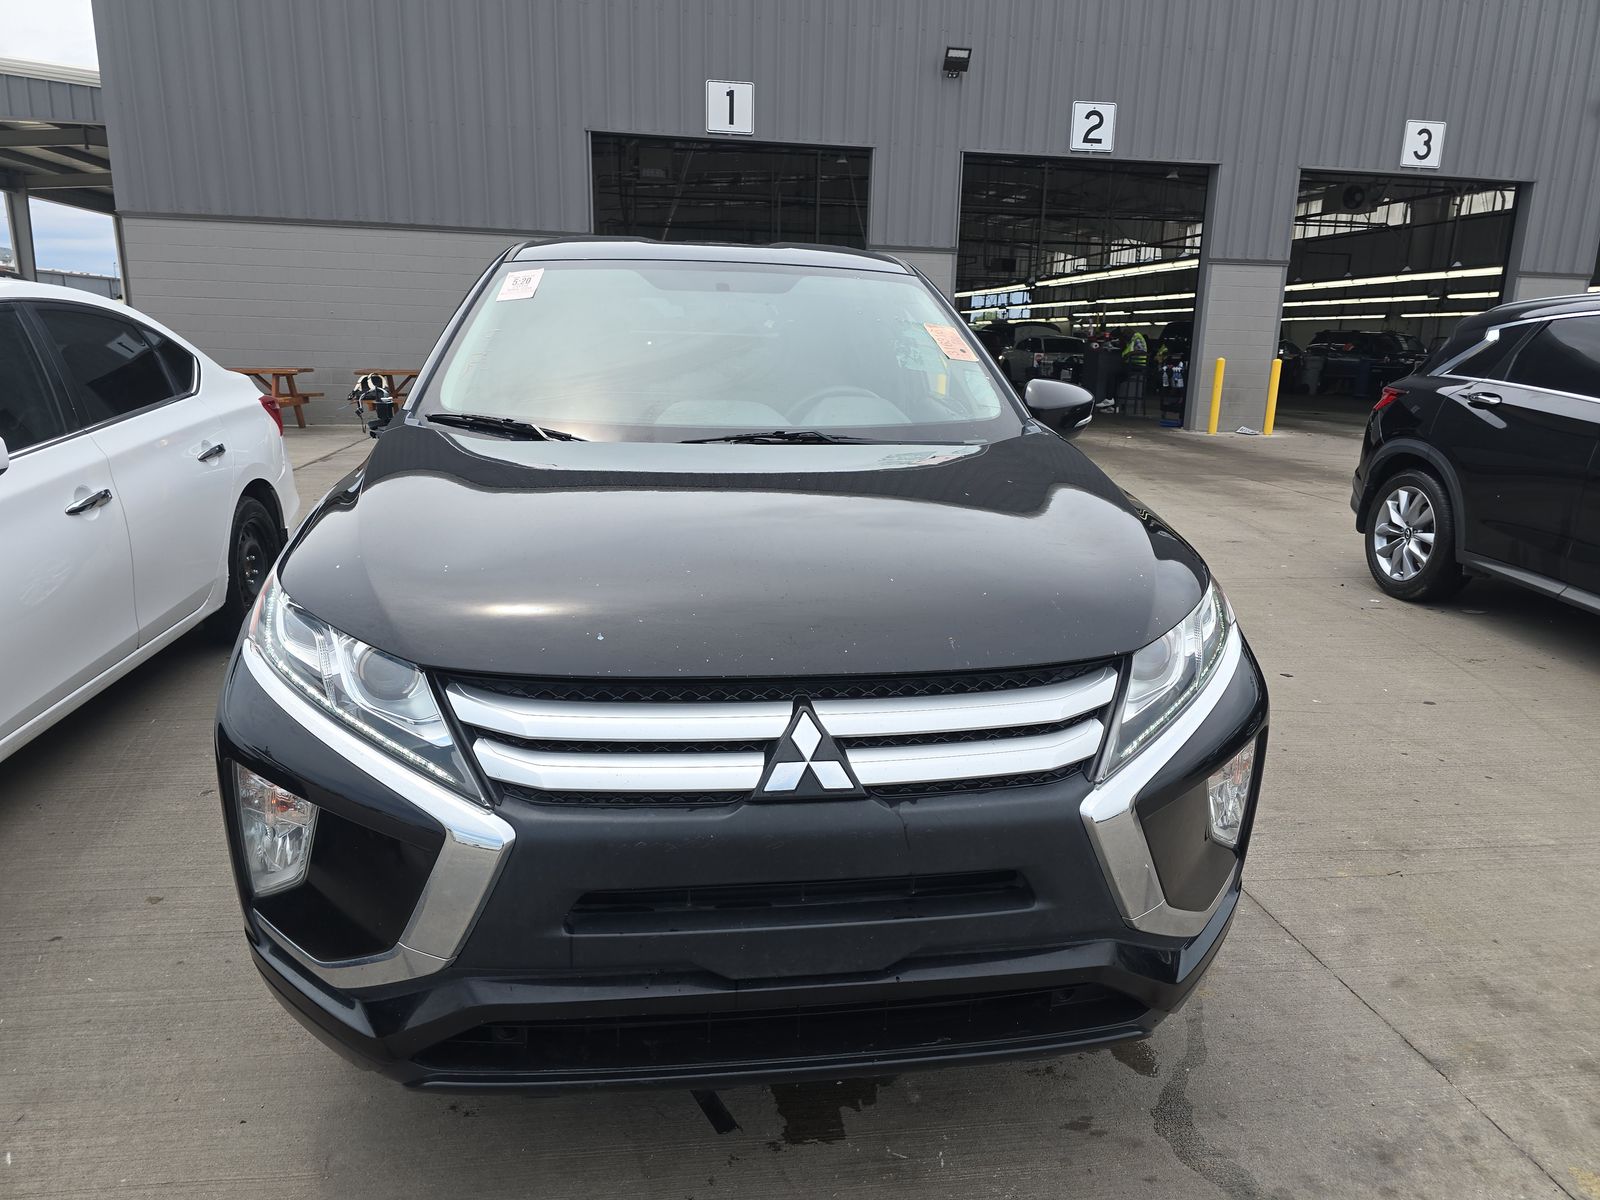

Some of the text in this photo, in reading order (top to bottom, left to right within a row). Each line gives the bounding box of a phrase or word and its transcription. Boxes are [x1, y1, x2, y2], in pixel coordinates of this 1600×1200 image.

[726, 89, 735, 126] 1
[1082, 109, 1104, 145] 2
[1413, 128, 1433, 161] 3
